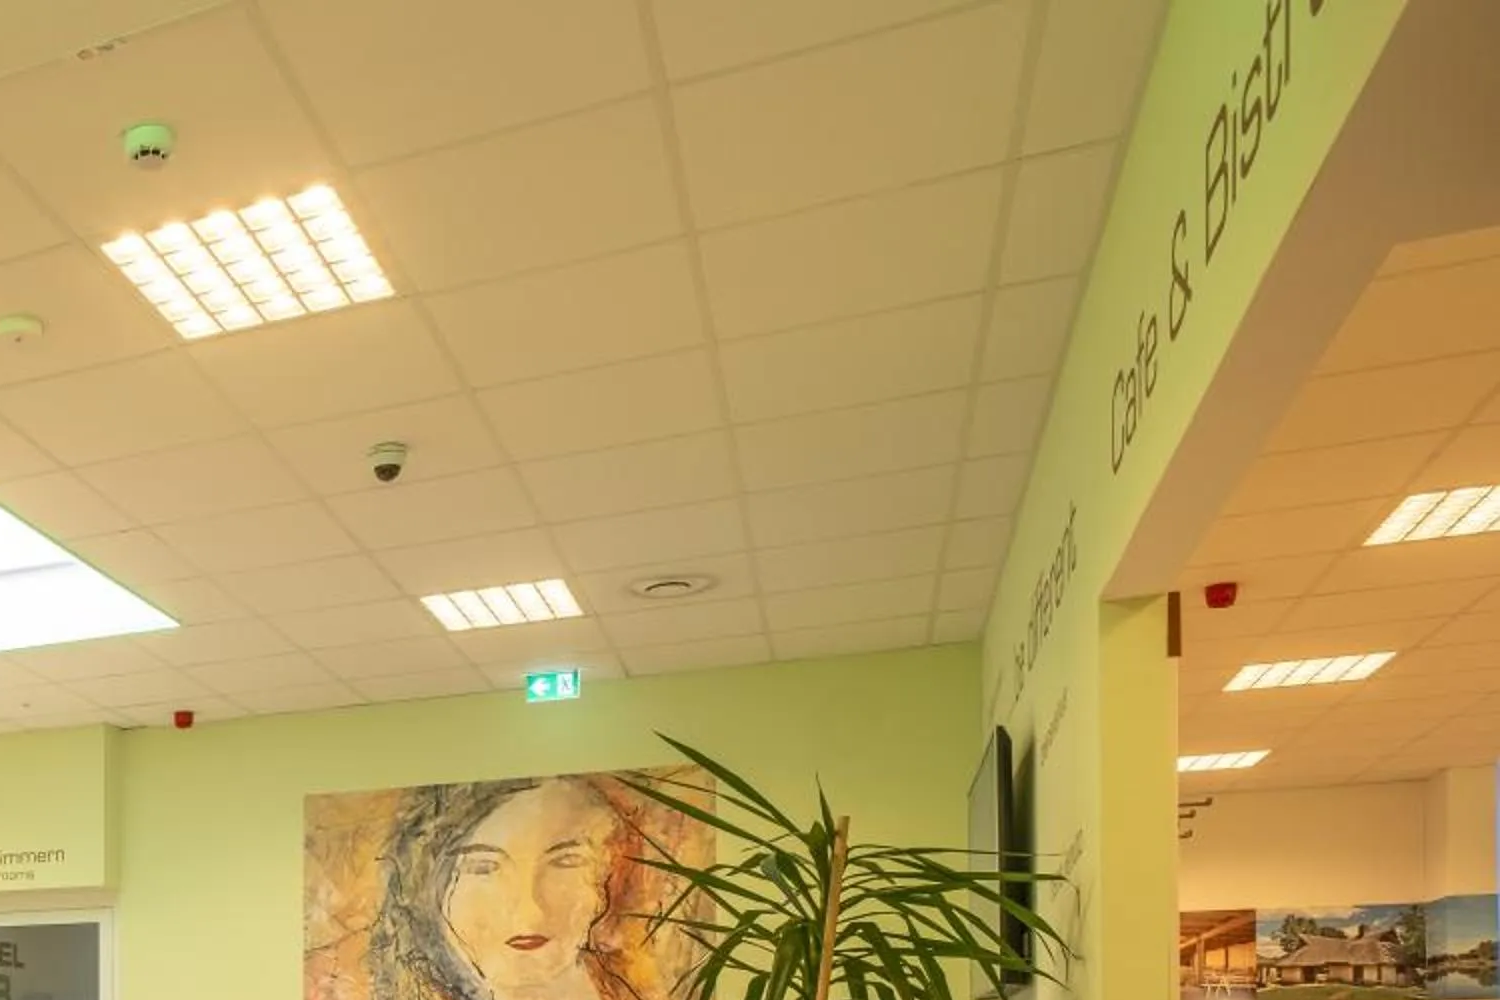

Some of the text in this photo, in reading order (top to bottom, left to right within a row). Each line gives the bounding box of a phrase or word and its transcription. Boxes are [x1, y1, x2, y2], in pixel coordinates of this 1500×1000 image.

[1111, 0, 1324, 475] Cafe & Bistr
